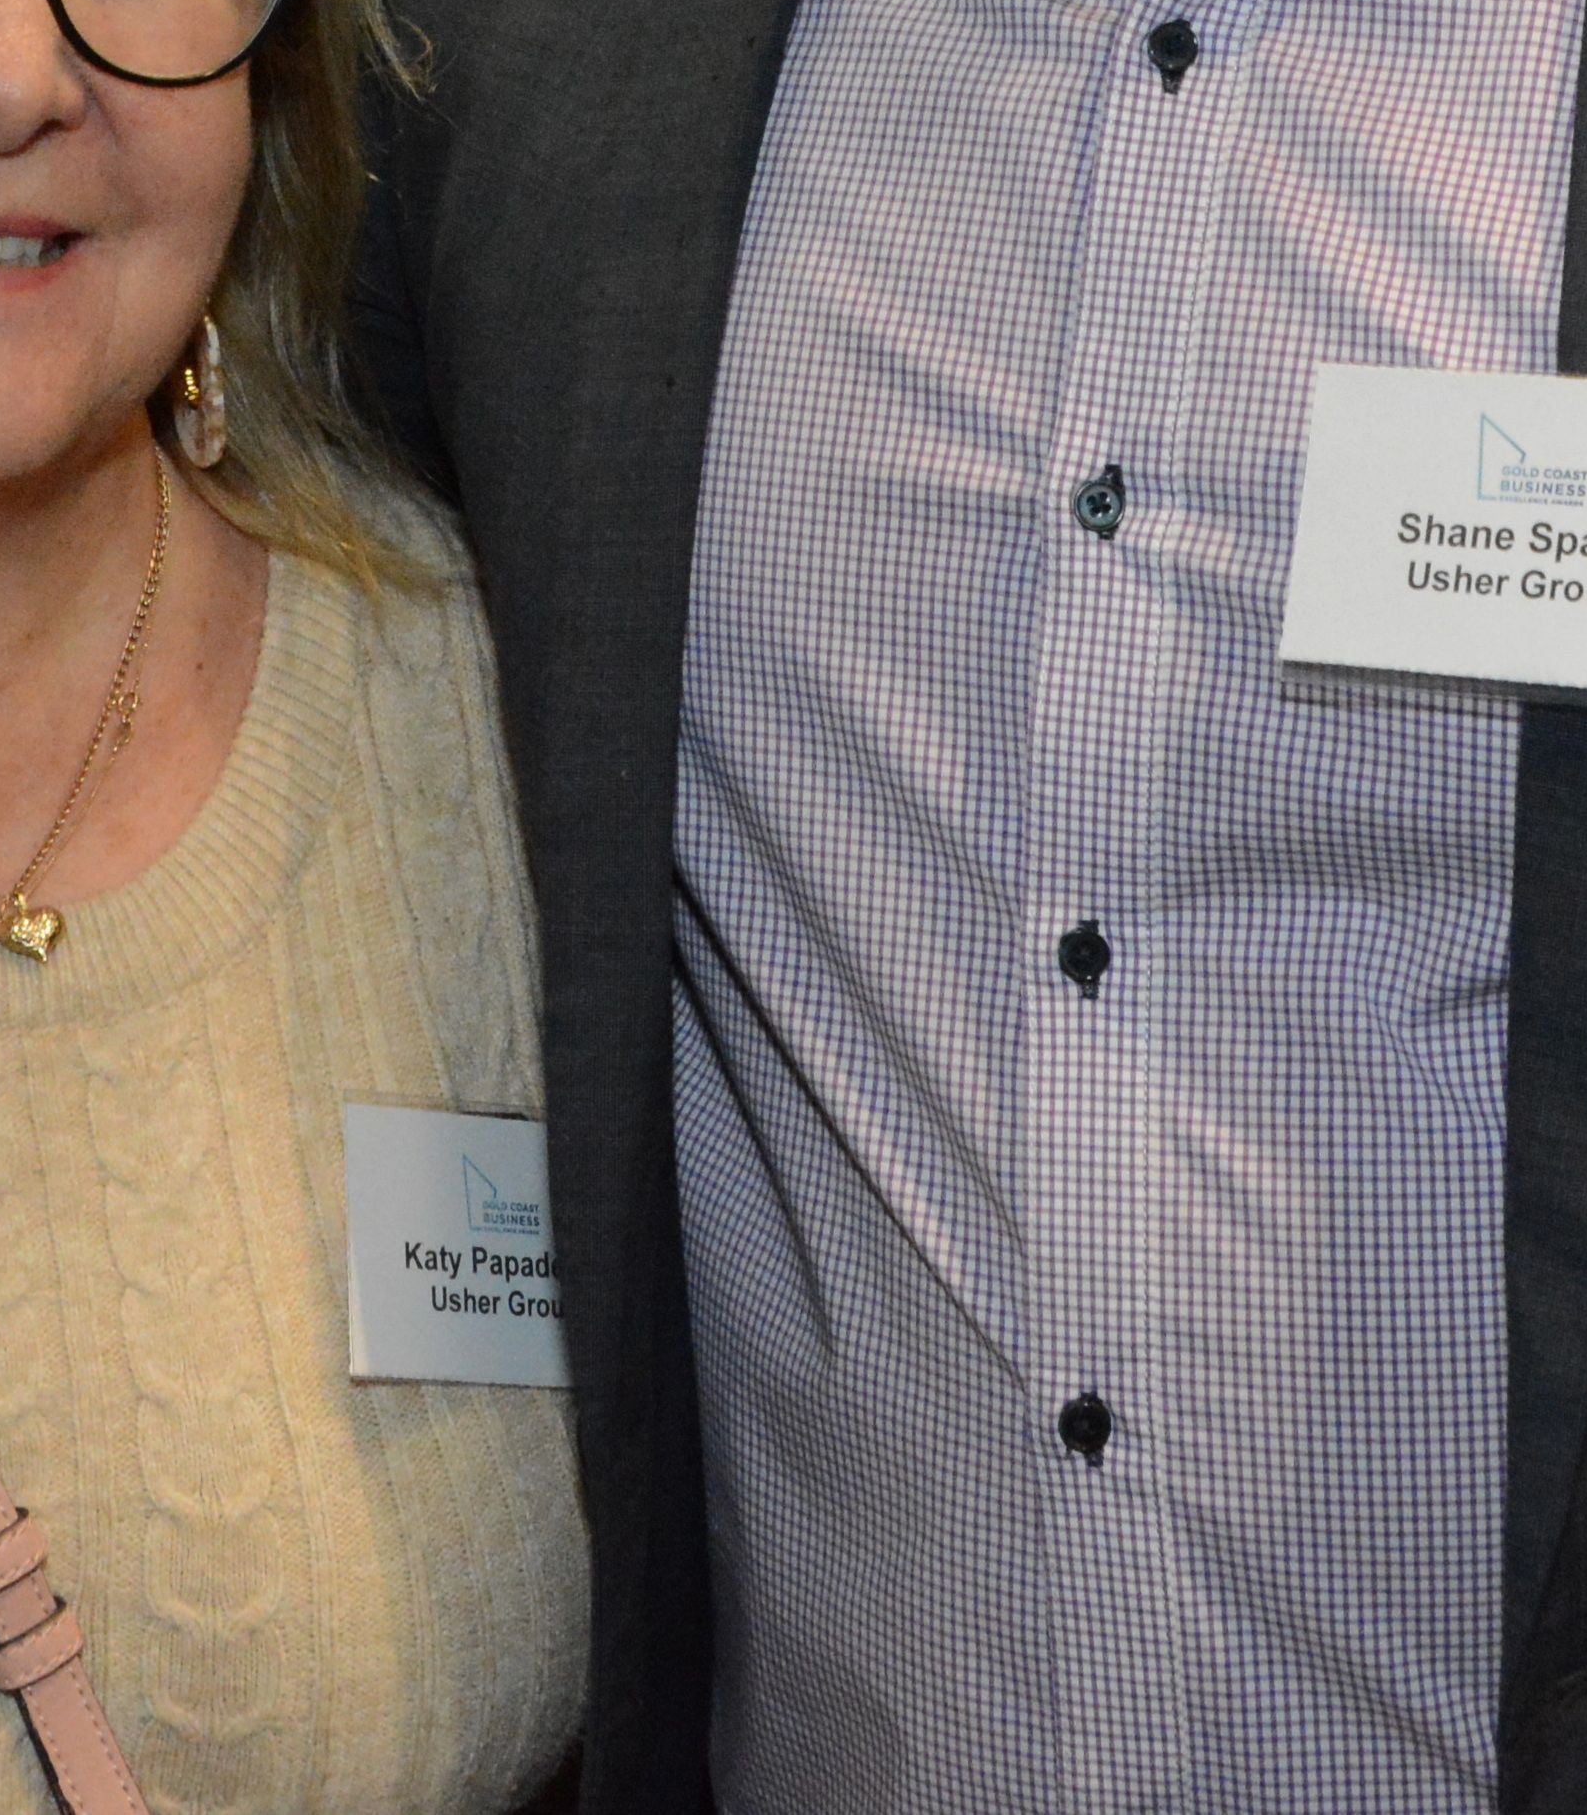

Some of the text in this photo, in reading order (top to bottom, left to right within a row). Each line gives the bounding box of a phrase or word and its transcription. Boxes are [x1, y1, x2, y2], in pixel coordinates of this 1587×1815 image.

[1501, 465, 1587, 481] GOLD COAST
[1500, 479, 1586, 497] BUSINESS
[1397, 512, 1515, 551] Shane
[1407, 560, 1509, 597] Usher
[483, 1212, 540, 1227] BUSINESS
[405, 1241, 462, 1279] Katy
[431, 1286, 500, 1315] Usher
